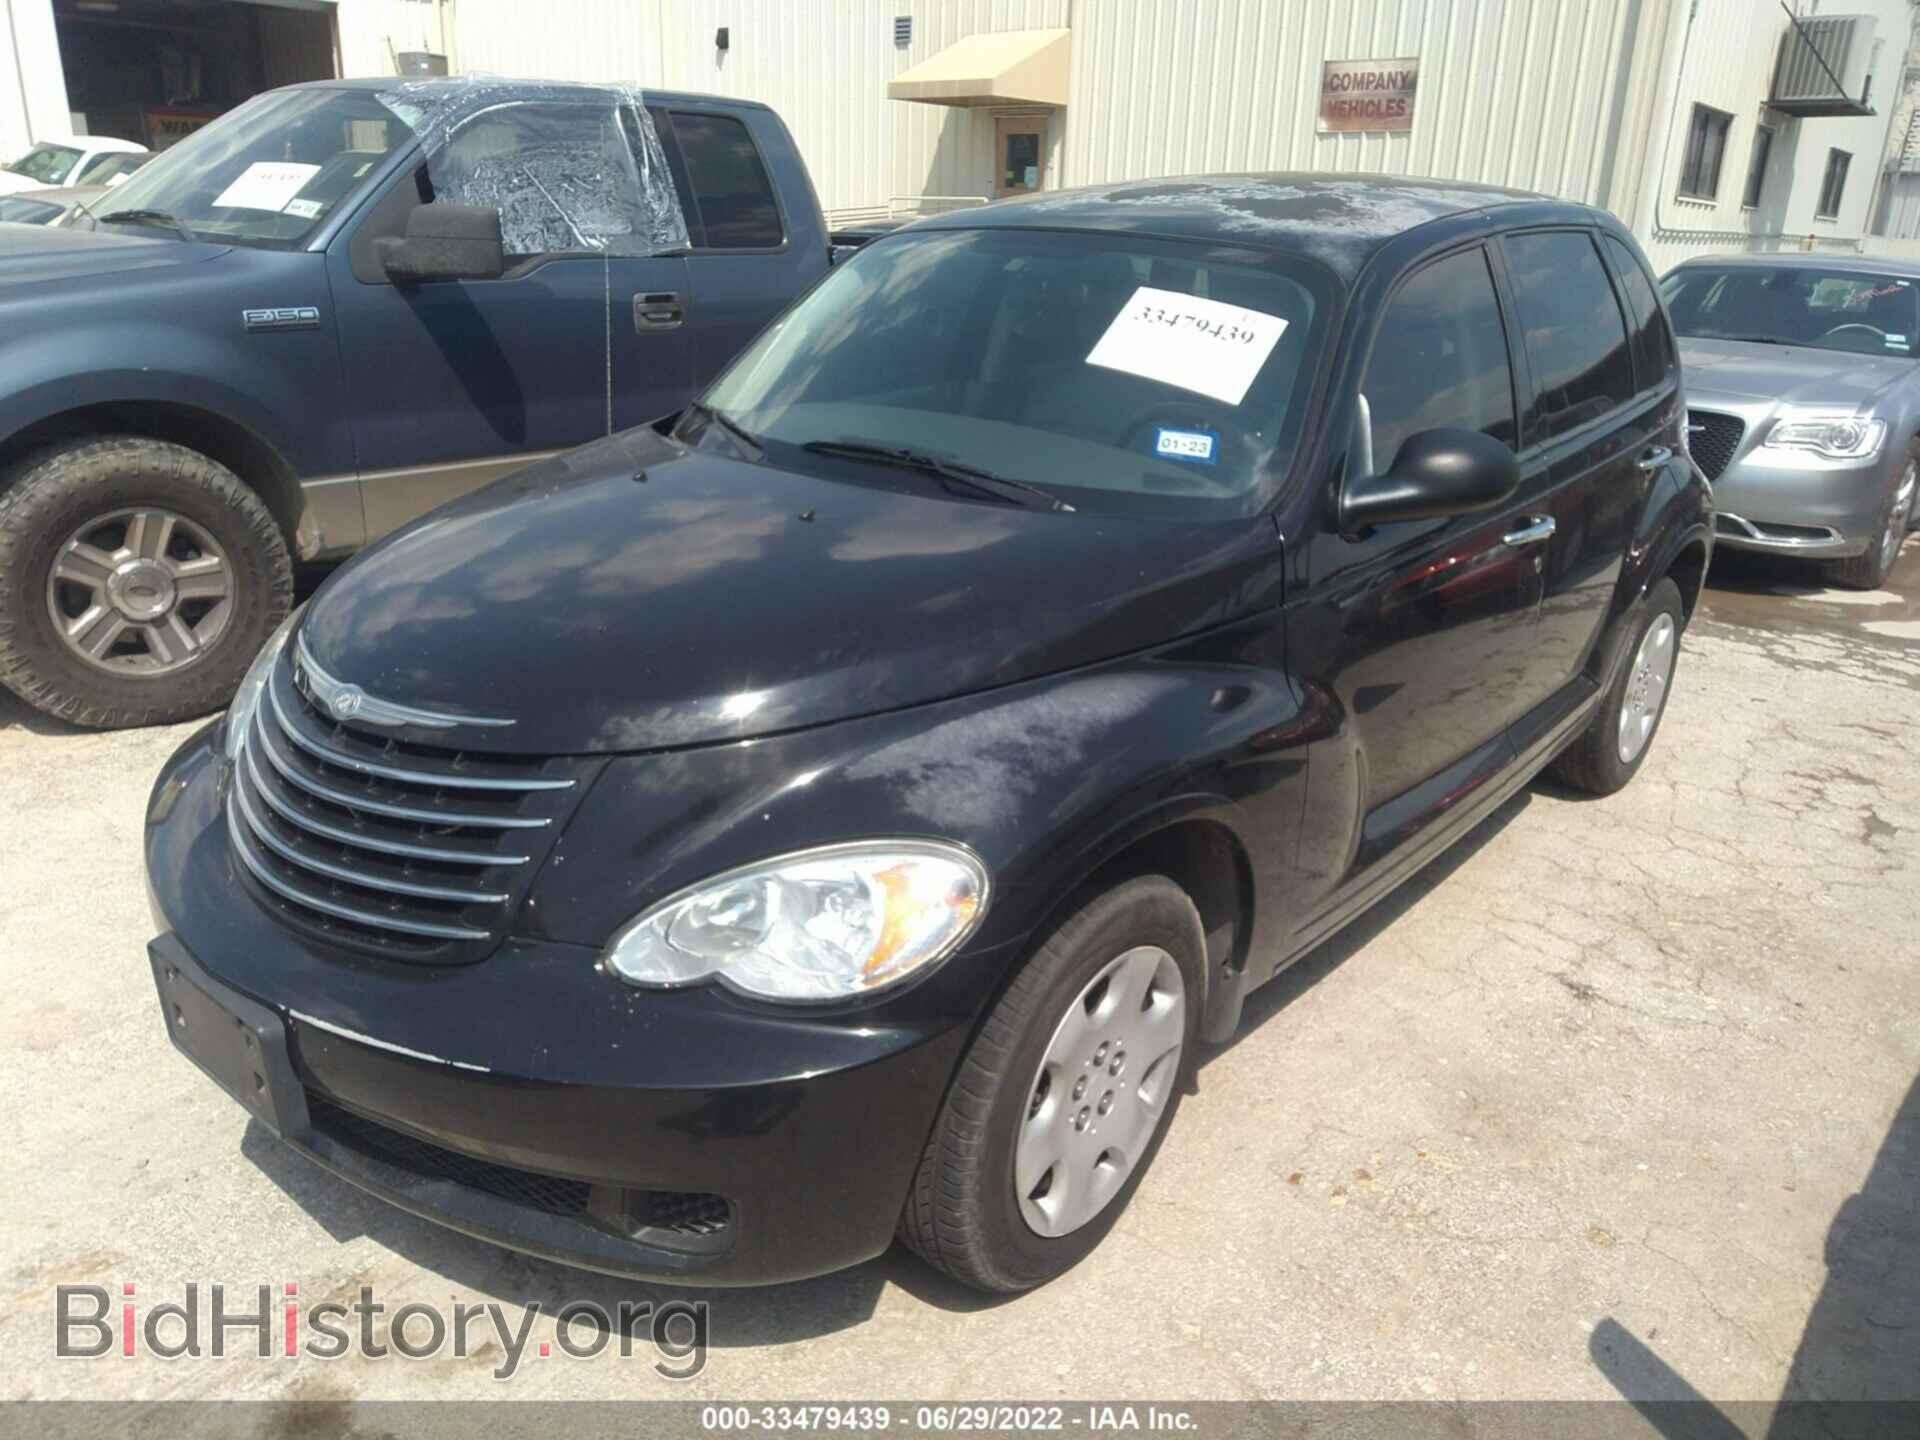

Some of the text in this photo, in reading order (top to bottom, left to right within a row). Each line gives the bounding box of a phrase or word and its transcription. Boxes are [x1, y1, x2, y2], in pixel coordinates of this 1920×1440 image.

[1329, 70, 1410, 91] COMPANY
[1326, 98, 1407, 119] VEHICLES
[1133, 305, 1256, 345] 33479439
[1160, 438, 1209, 453] 01-23
